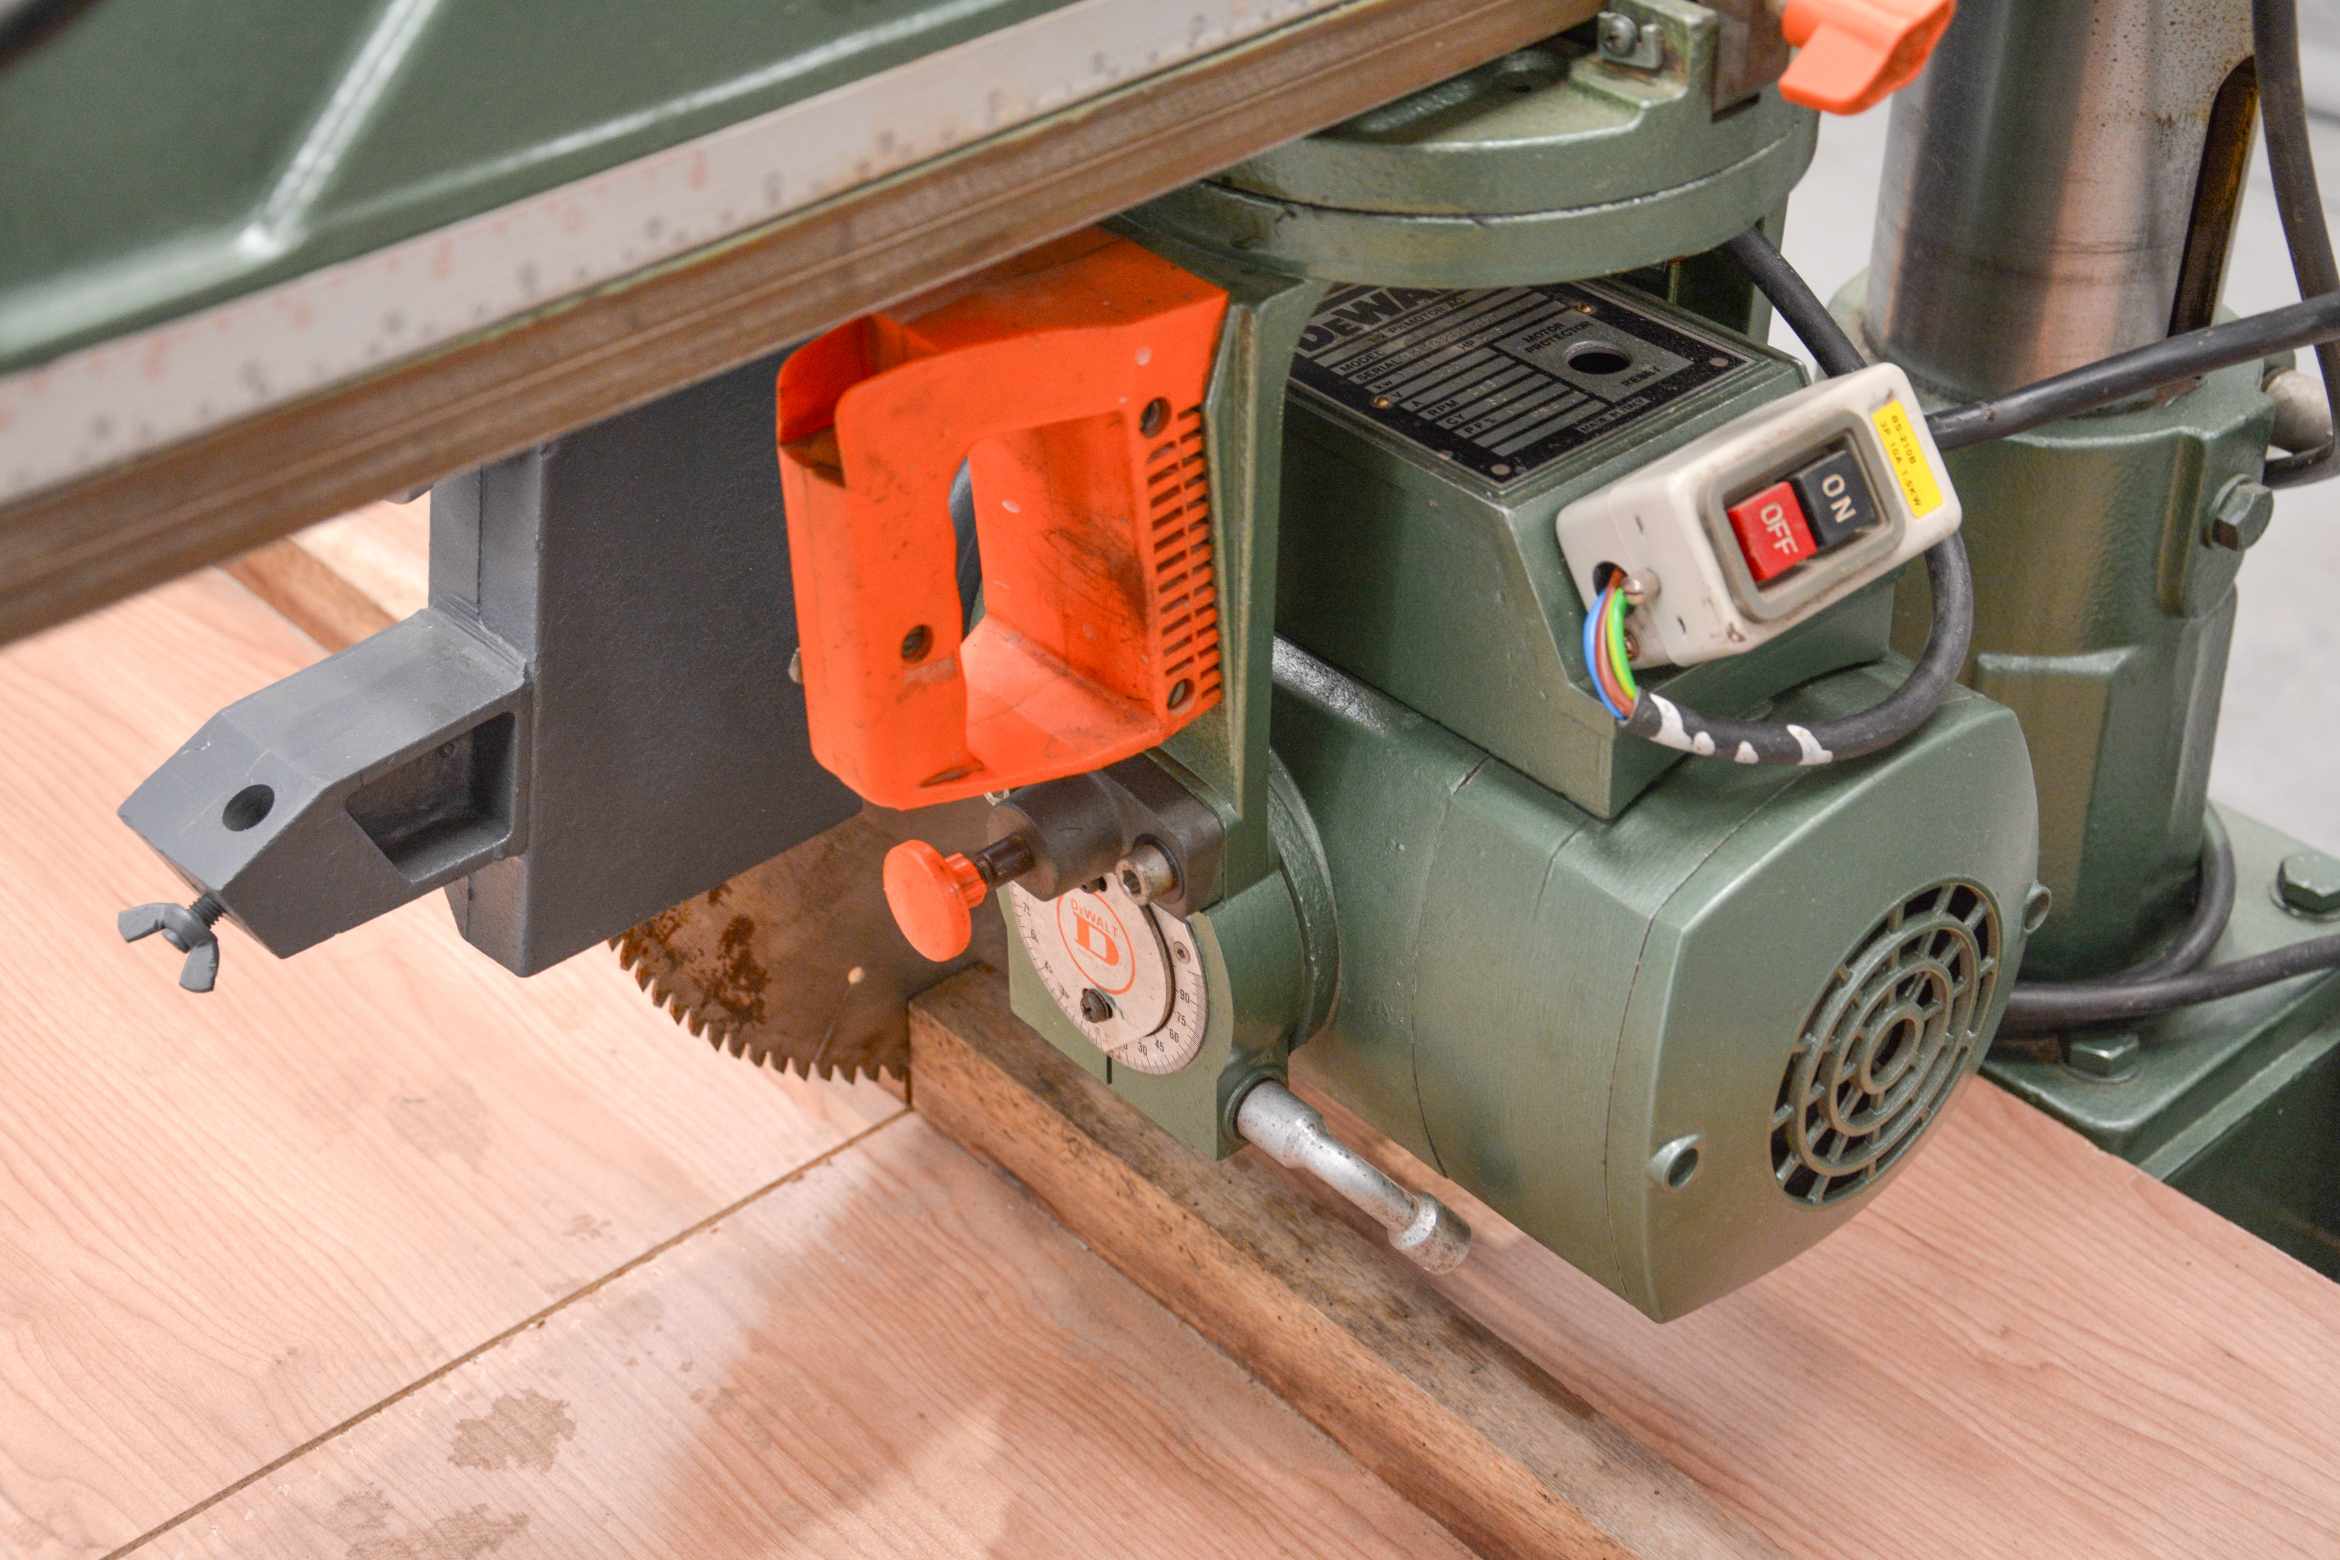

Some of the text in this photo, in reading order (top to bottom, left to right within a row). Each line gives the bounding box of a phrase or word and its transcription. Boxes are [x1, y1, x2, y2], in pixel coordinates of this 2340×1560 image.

[1522, 321, 1566, 343] MOTOR
[1525, 320, 1595, 353] PROTECTOR
[1339, 351, 1385, 372] MODEL
[1357, 358, 1403, 381] SERIAL
[1428, 400, 1459, 416] RPM
[1822, 474, 1857, 523] ON
[1760, 502, 1799, 556] OFF
[1180, 988, 1190, 1004] 90
